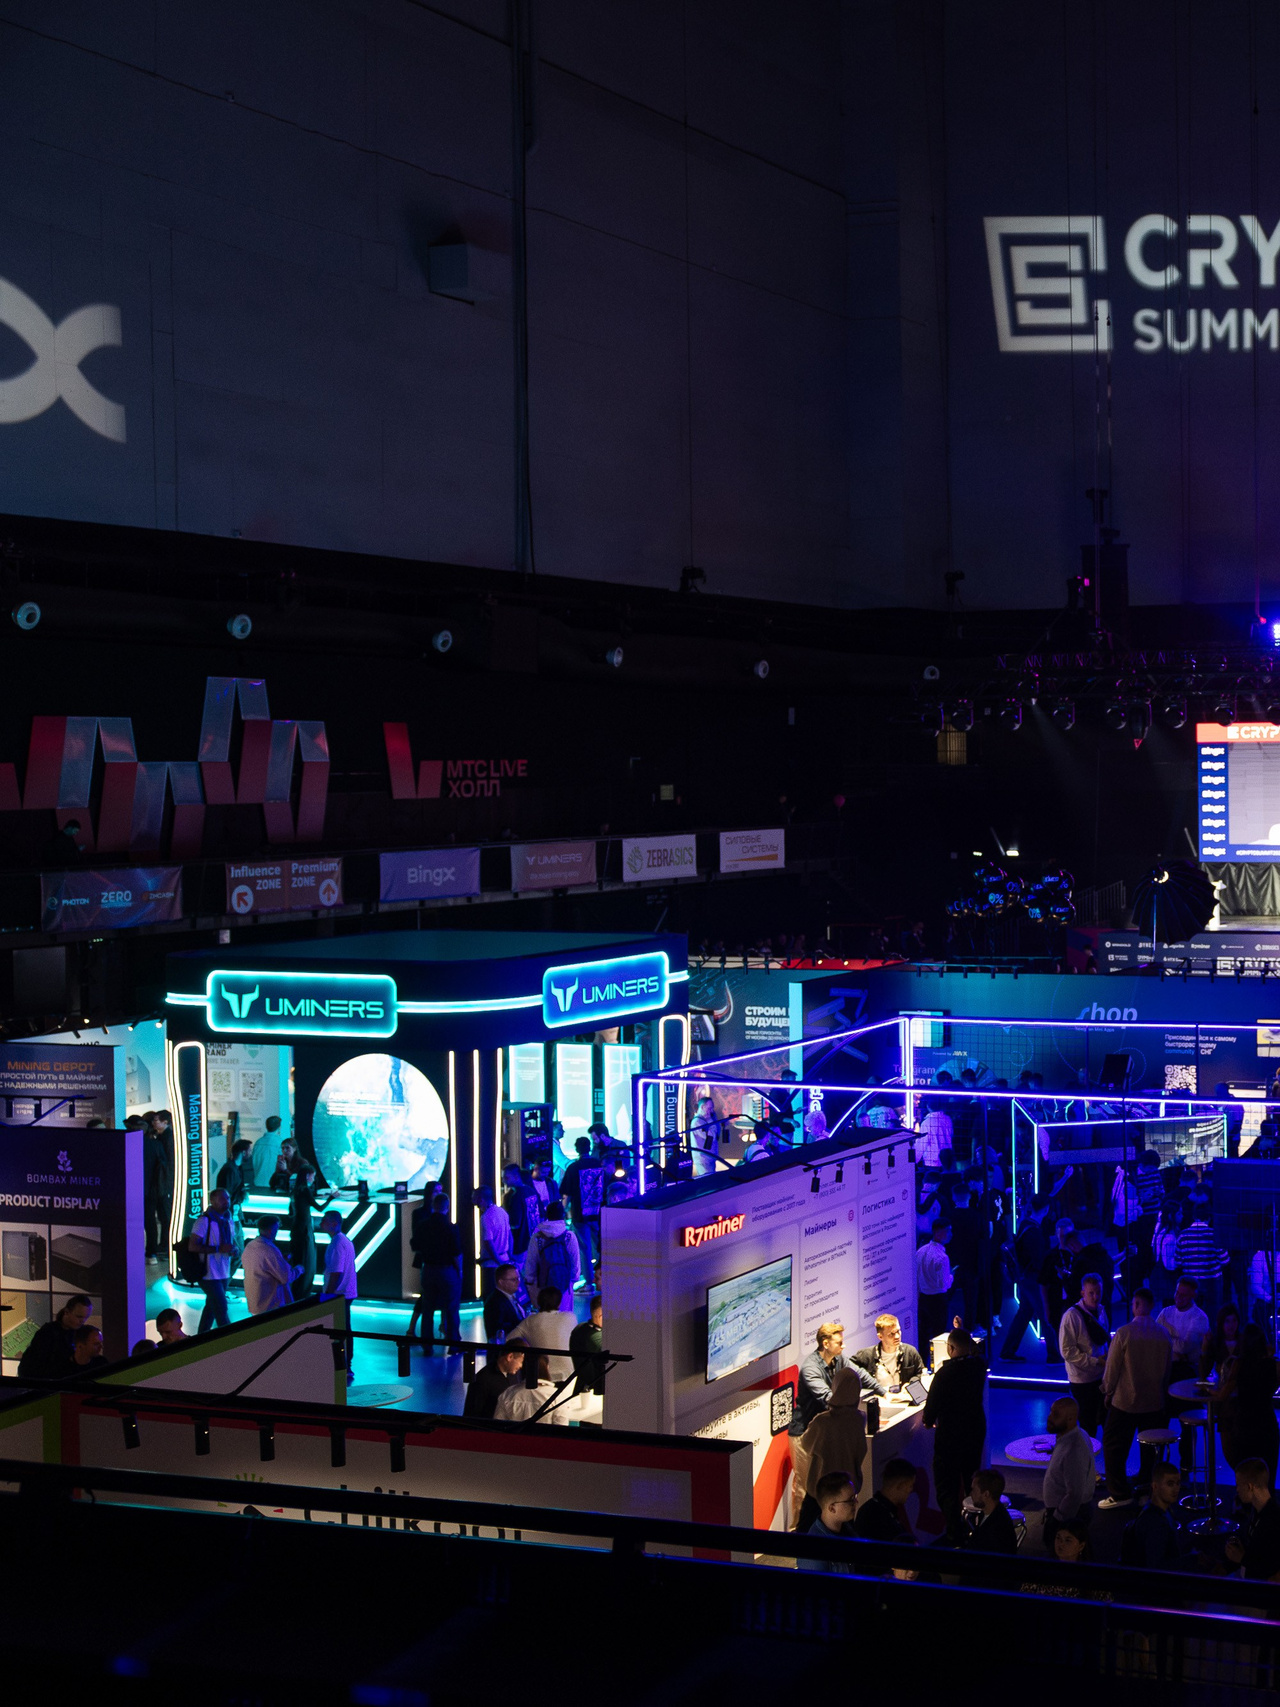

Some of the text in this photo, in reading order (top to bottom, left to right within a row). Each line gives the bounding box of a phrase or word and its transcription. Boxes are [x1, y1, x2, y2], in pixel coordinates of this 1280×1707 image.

[448, 779, 500, 798] ХОЛЛ
[647, 847, 693, 868] ZEBRASICS
[230, 865, 282, 879] Influence
[291, 860, 339, 874] Premium
[256, 878, 282, 891] ZONE
[291, 876, 315, 888] ZONE
[101, 890, 131, 904] ZERO
[582, 977, 659, 1004] UMINERS
[265, 998, 384, 1019] UMINERS
[745, 1006, 786, 1016] СТРОИМ
[7, 1061, 96, 1072] MINING DEPOT
[893, 1064, 936, 1075] Tegram
[38, 1073, 58, 1081] ПУТЬ
[66, 1074, 104, 1082] МАЙНИНГ
[188, 1094, 202, 1220] Making Mining Easy
[27, 1173, 100, 1186] BOMBAX MINER
[0, 1193, 100, 1210] PRODUCT DISPLAY
[862, 1196, 896, 1216] Логистика
[685, 1213, 746, 1248] R7miner
[804, 1218, 837, 1237] Майнеры
